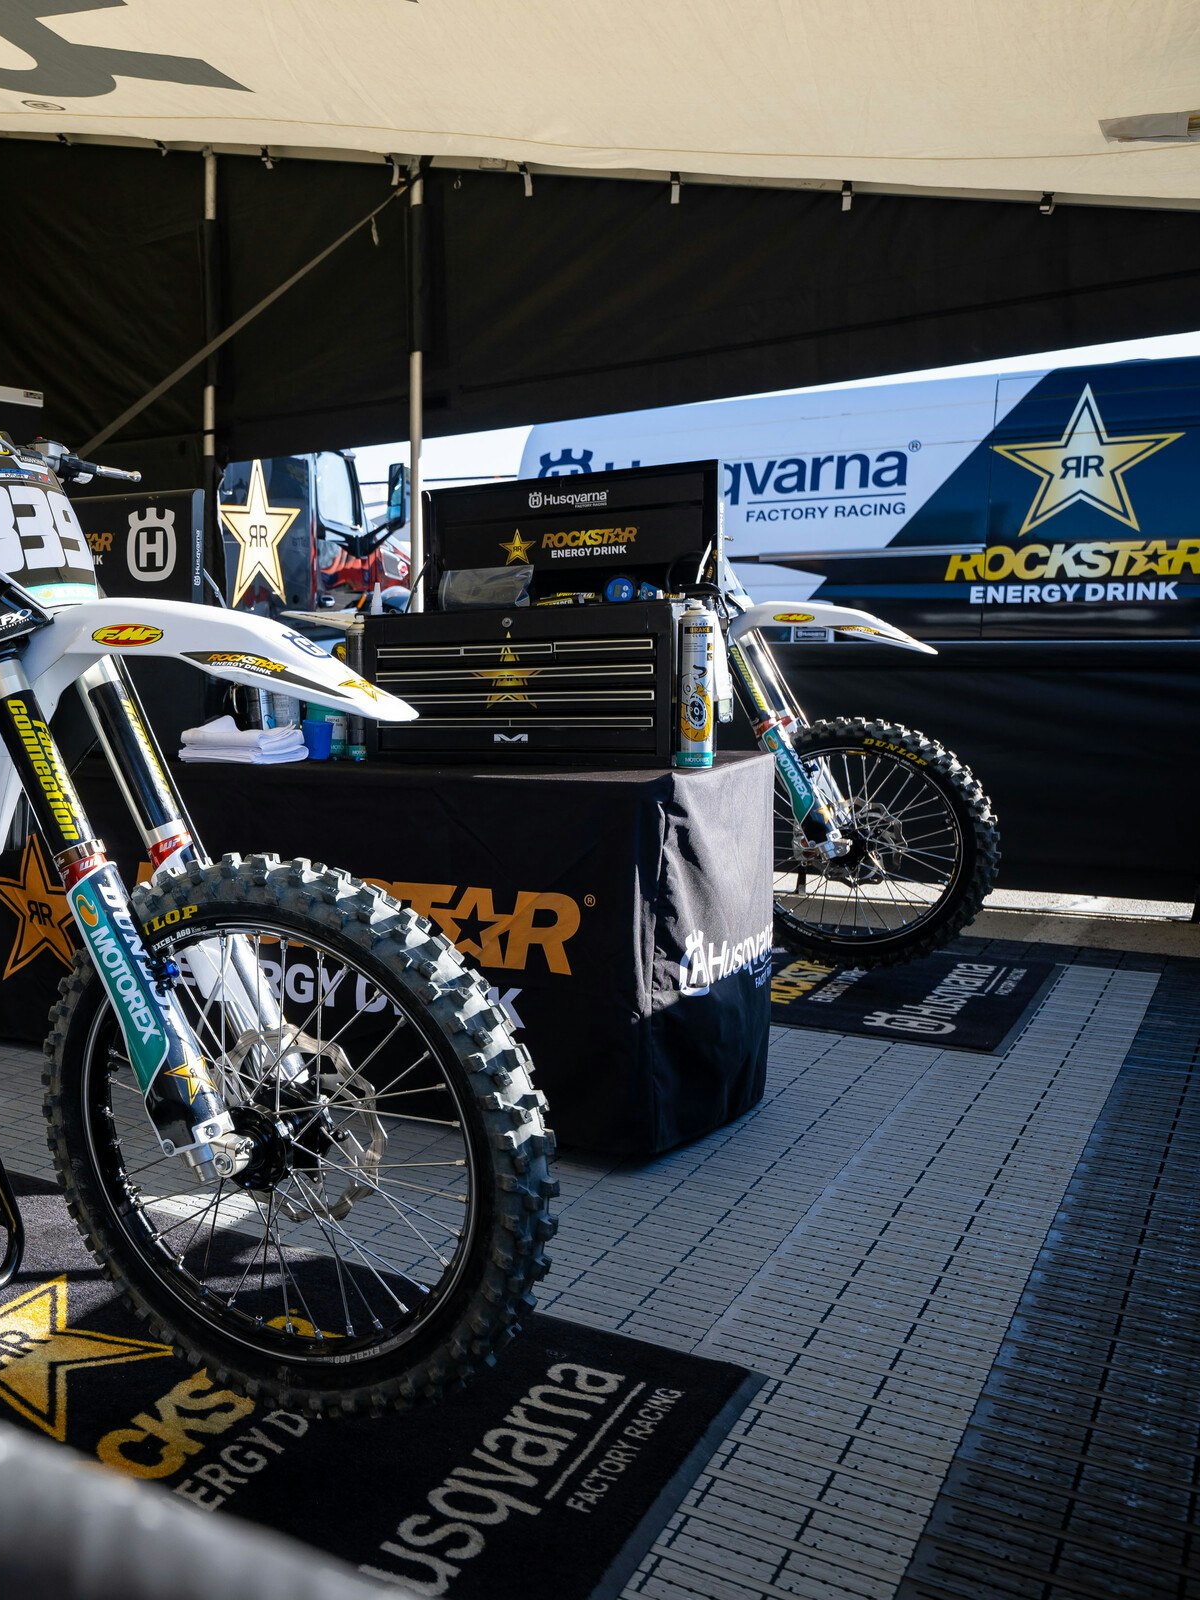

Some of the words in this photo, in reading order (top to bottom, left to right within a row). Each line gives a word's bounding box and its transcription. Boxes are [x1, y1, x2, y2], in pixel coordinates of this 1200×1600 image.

[543, 491, 608, 506] Husqvarna
[745, 507, 826, 523] FACTORY
[833, 501, 906, 517] RACING
[541, 527, 638, 548] ROCKSTAR
[551, 547, 592, 559] ENERGY
[593, 545, 627, 556] DRINK
[944, 539, 1200, 582] ROCKSTAR
[969, 583, 1080, 604] ENERGY
[1084, 581, 1179, 601] DRINK
[93, 627, 164, 641] FMF
[207, 653, 286, 673] ROCKSTAR
[210, 661, 244, 669] ENERGY
[244, 664, 272, 675] DRINK
[863, 738, 928, 766] DUNLOP
[7, 699, 80, 841] connection
[776, 749, 811, 800] MOTOREX
[90, 925, 161, 1045] MOTOREX
[897, 963, 998, 1020] Husqvarna
[565, 1439, 641, 1513] FACTORY
[623, 1388, 682, 1440] RACING
